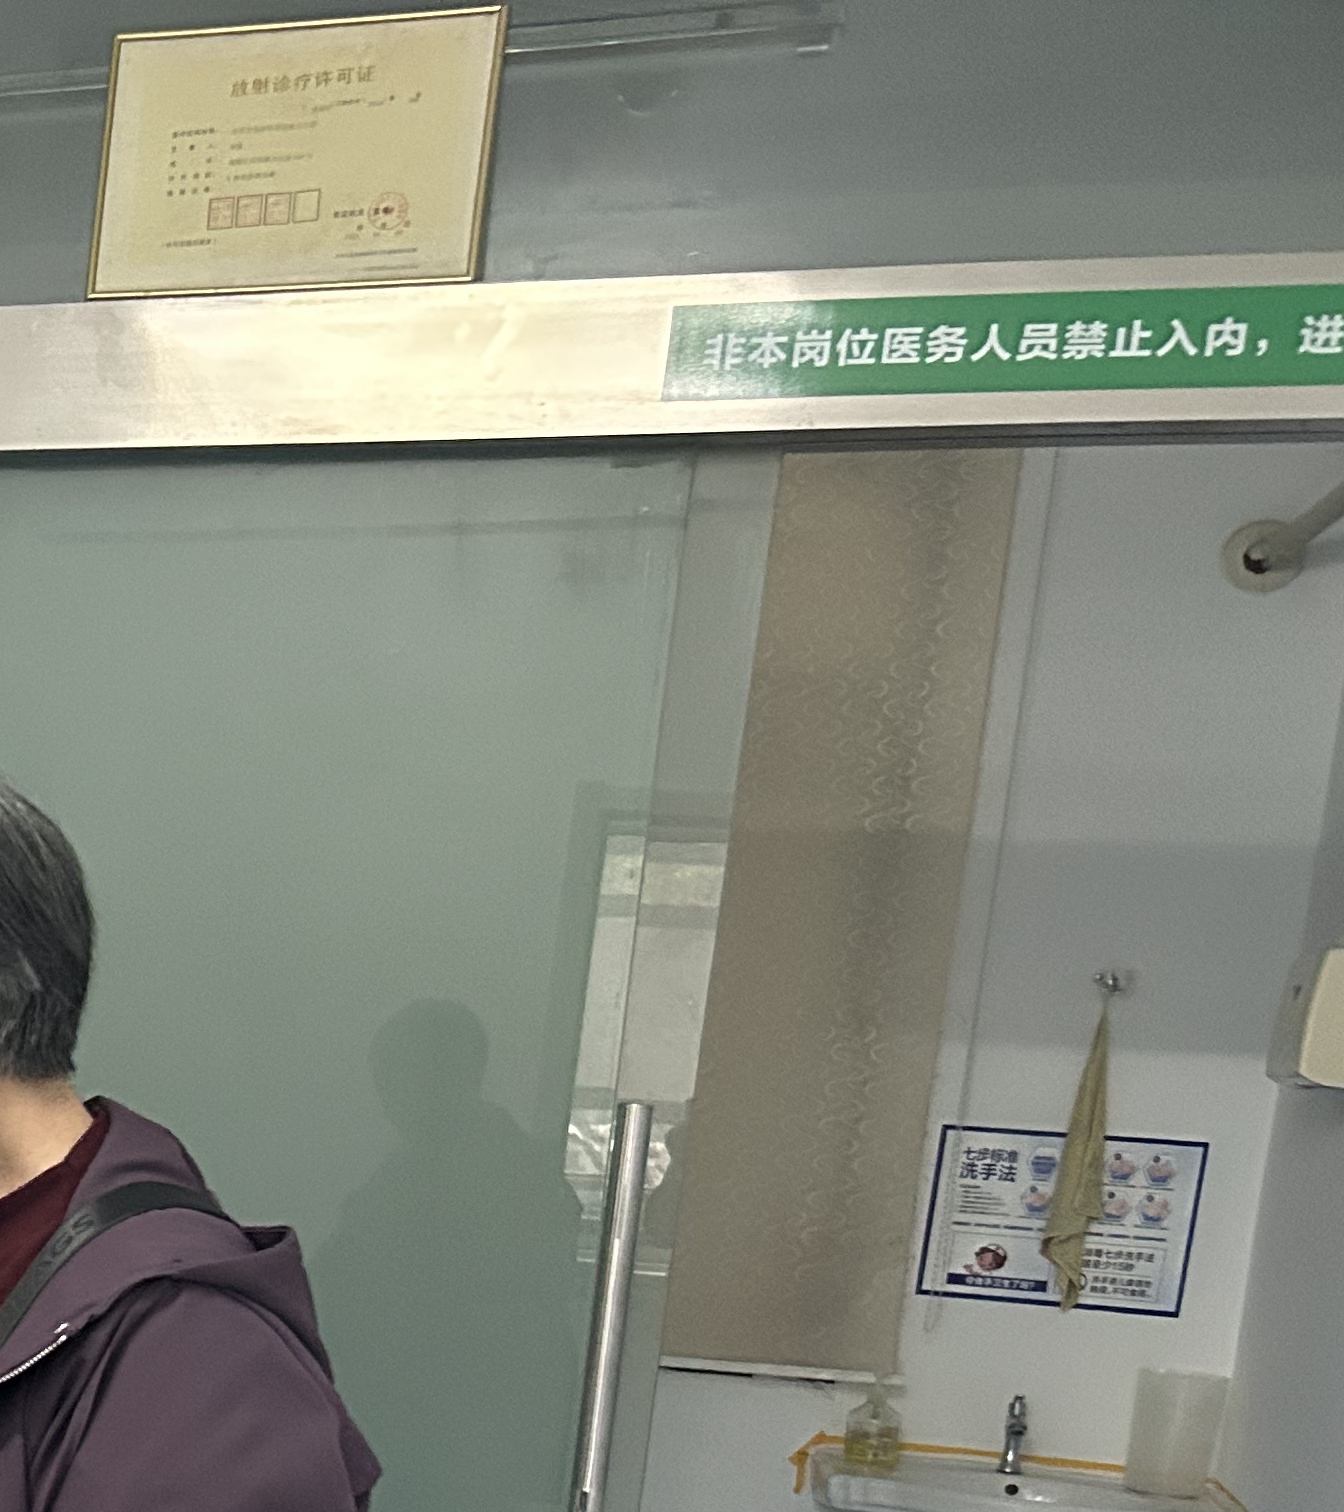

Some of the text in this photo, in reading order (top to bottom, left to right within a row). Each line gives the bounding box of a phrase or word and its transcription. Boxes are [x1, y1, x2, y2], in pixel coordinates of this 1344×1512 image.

[231, 65, 377, 98] 放射诊疗许可证
[703, 315, 1344, 372] 非本岗位医务人员禁止入内，进
[959, 1162, 1017, 1183] 洗手法
